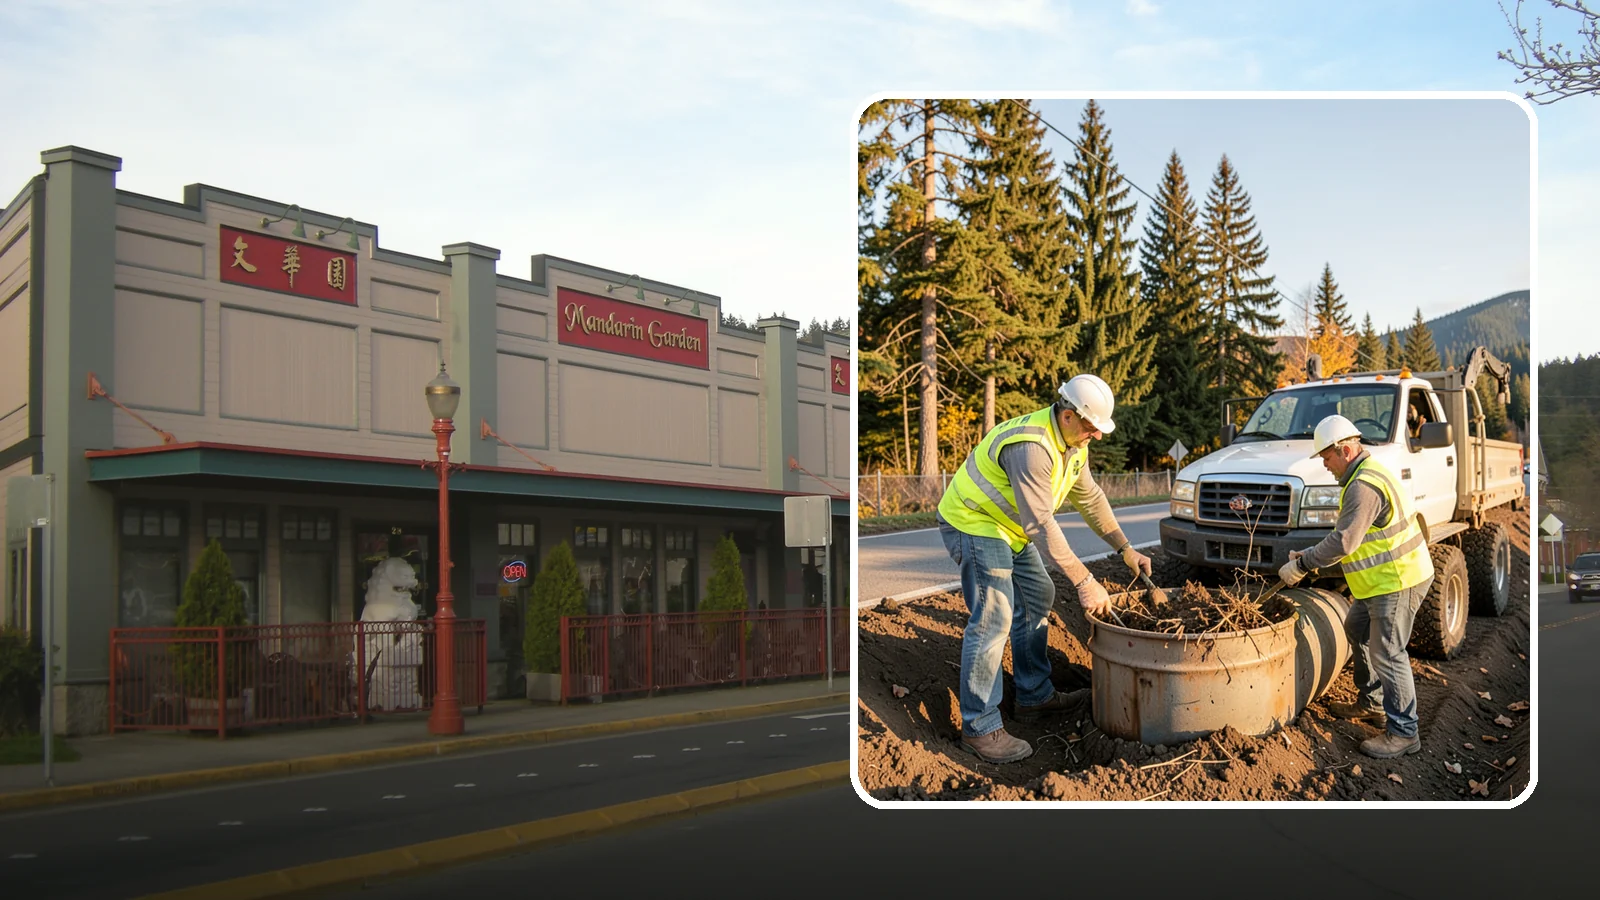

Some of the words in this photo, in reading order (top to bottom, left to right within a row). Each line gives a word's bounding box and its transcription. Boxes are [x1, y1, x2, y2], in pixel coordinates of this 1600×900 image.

[230, 235, 346, 291] 文華園
[564, 302, 644, 341] Mandarin
[648, 320, 701, 352] Garden
[503, 565, 527, 578] OPEN
